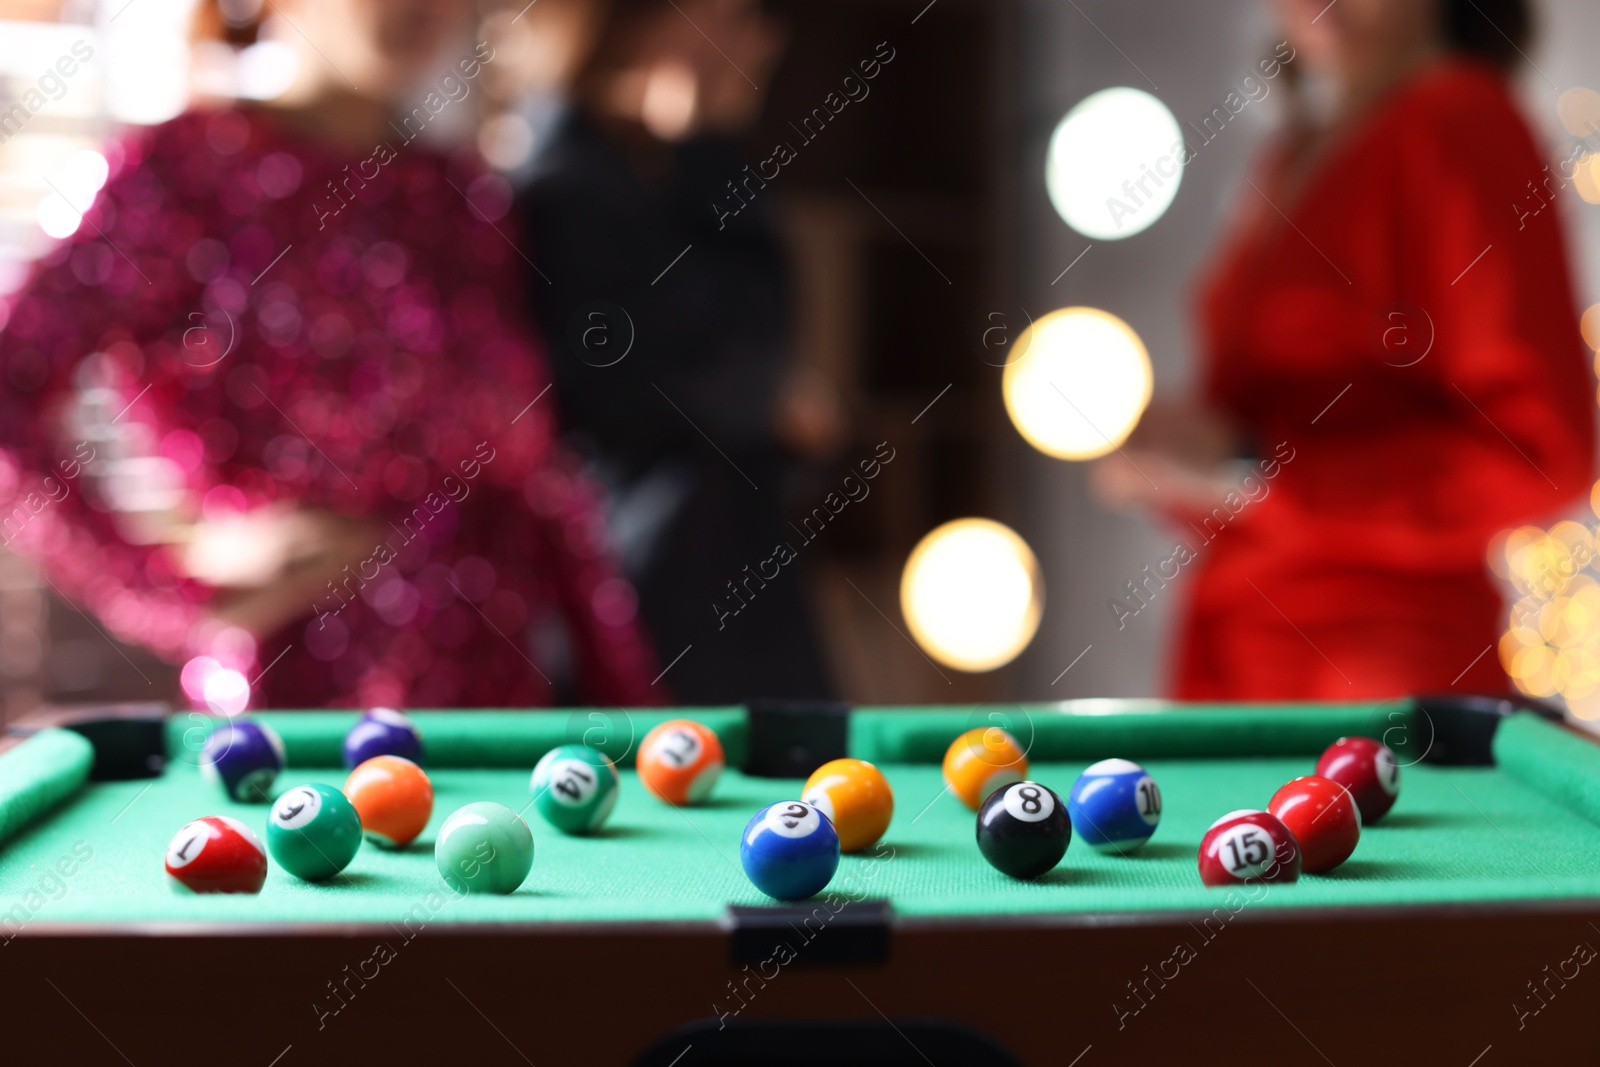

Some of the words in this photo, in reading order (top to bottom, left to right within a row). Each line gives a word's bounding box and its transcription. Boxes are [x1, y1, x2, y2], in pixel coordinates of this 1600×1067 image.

[1018, 786, 1042, 815] 8
[1139, 782, 1160, 816] 10
[176, 836, 197, 861] 1
[1226, 831, 1268, 872] 15
